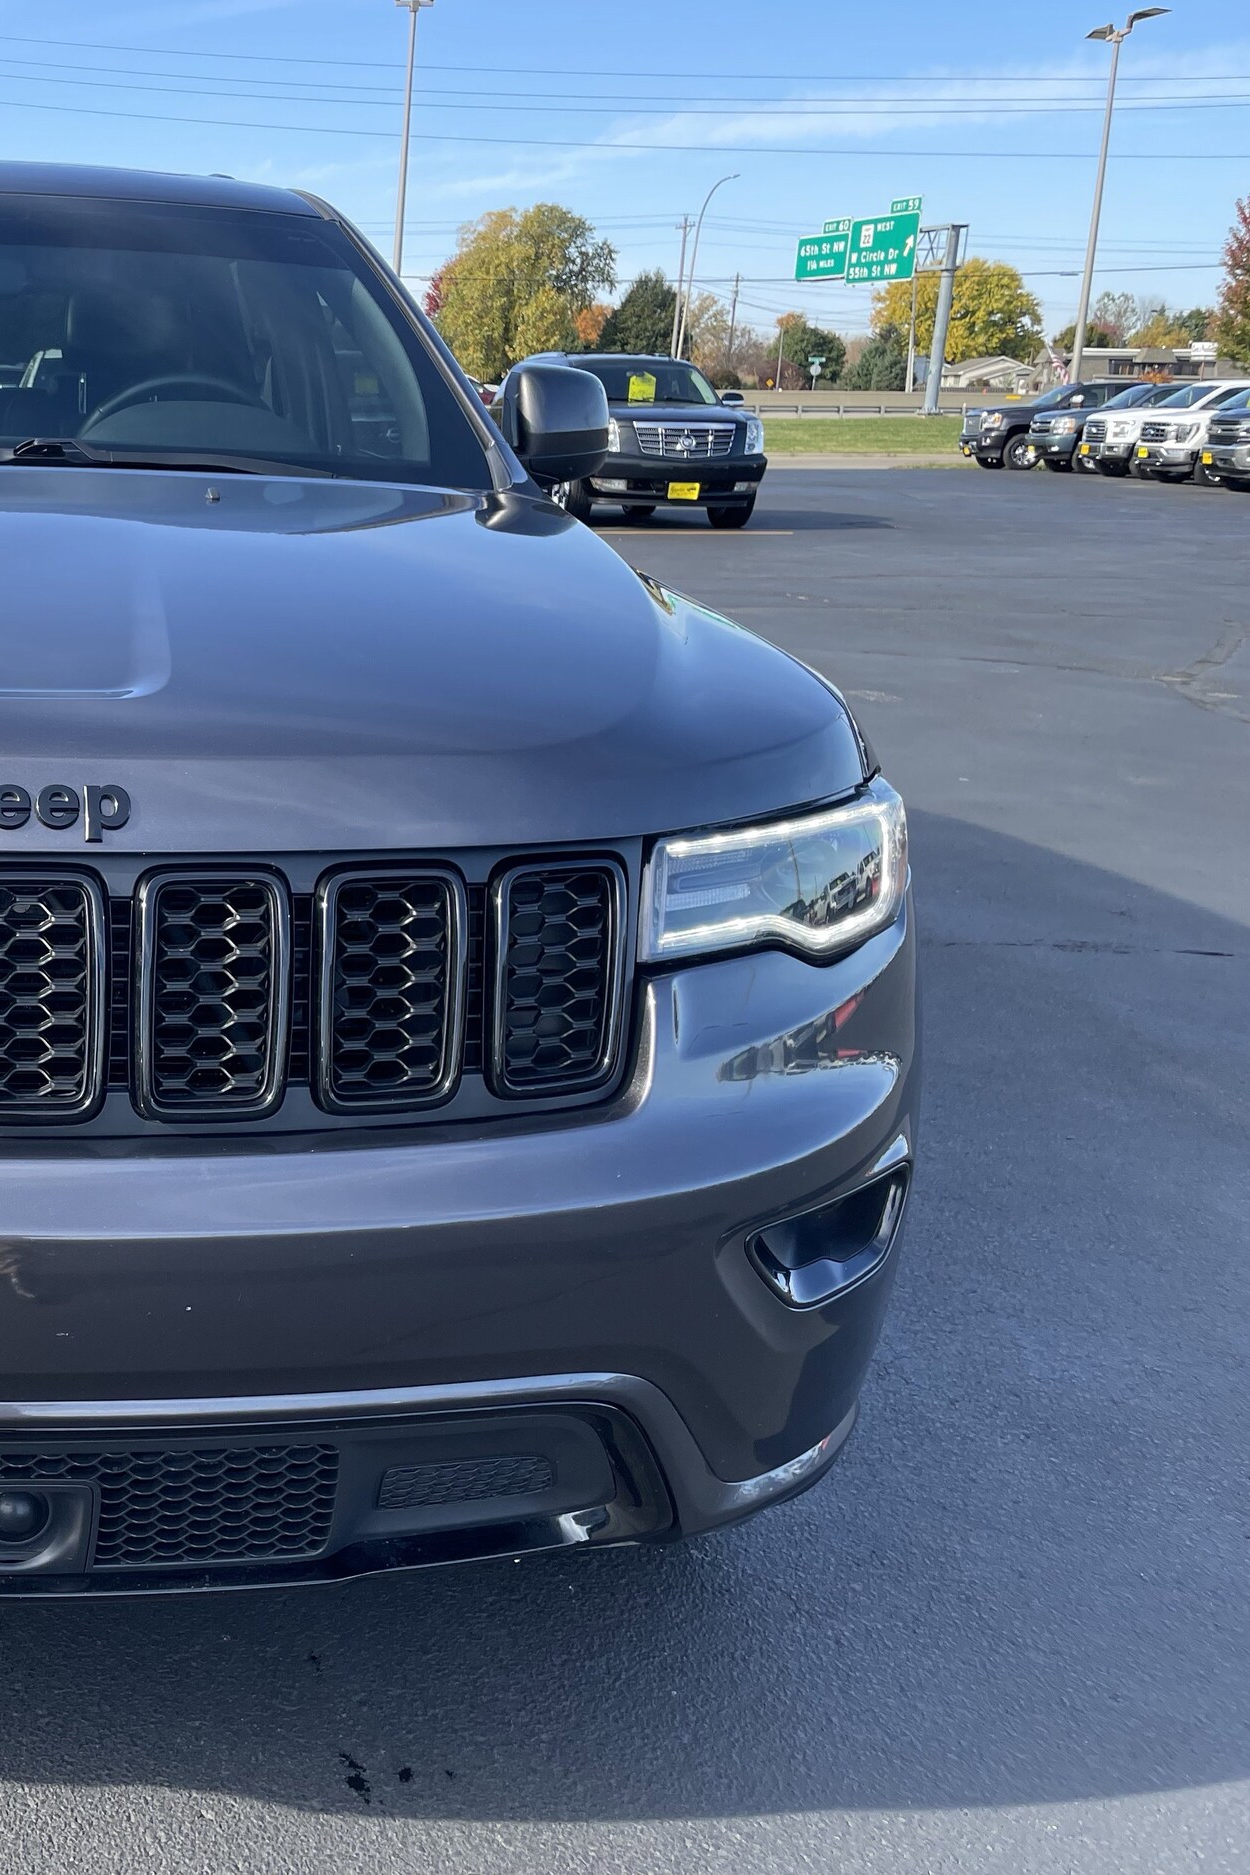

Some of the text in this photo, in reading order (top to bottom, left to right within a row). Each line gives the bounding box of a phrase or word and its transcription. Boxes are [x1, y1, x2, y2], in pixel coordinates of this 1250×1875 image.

[893, 199, 920, 211] EXIT 59
[825, 220, 849, 232] EXIT 60
[877, 221, 895, 232] WEST
[862, 234, 872, 245] 22
[800, 240, 846, 257] 65th St NW
[851, 248, 899, 264] W Circle Dr
[819, 258, 835, 268] MILES
[848, 263, 898, 279] 55th St NW
